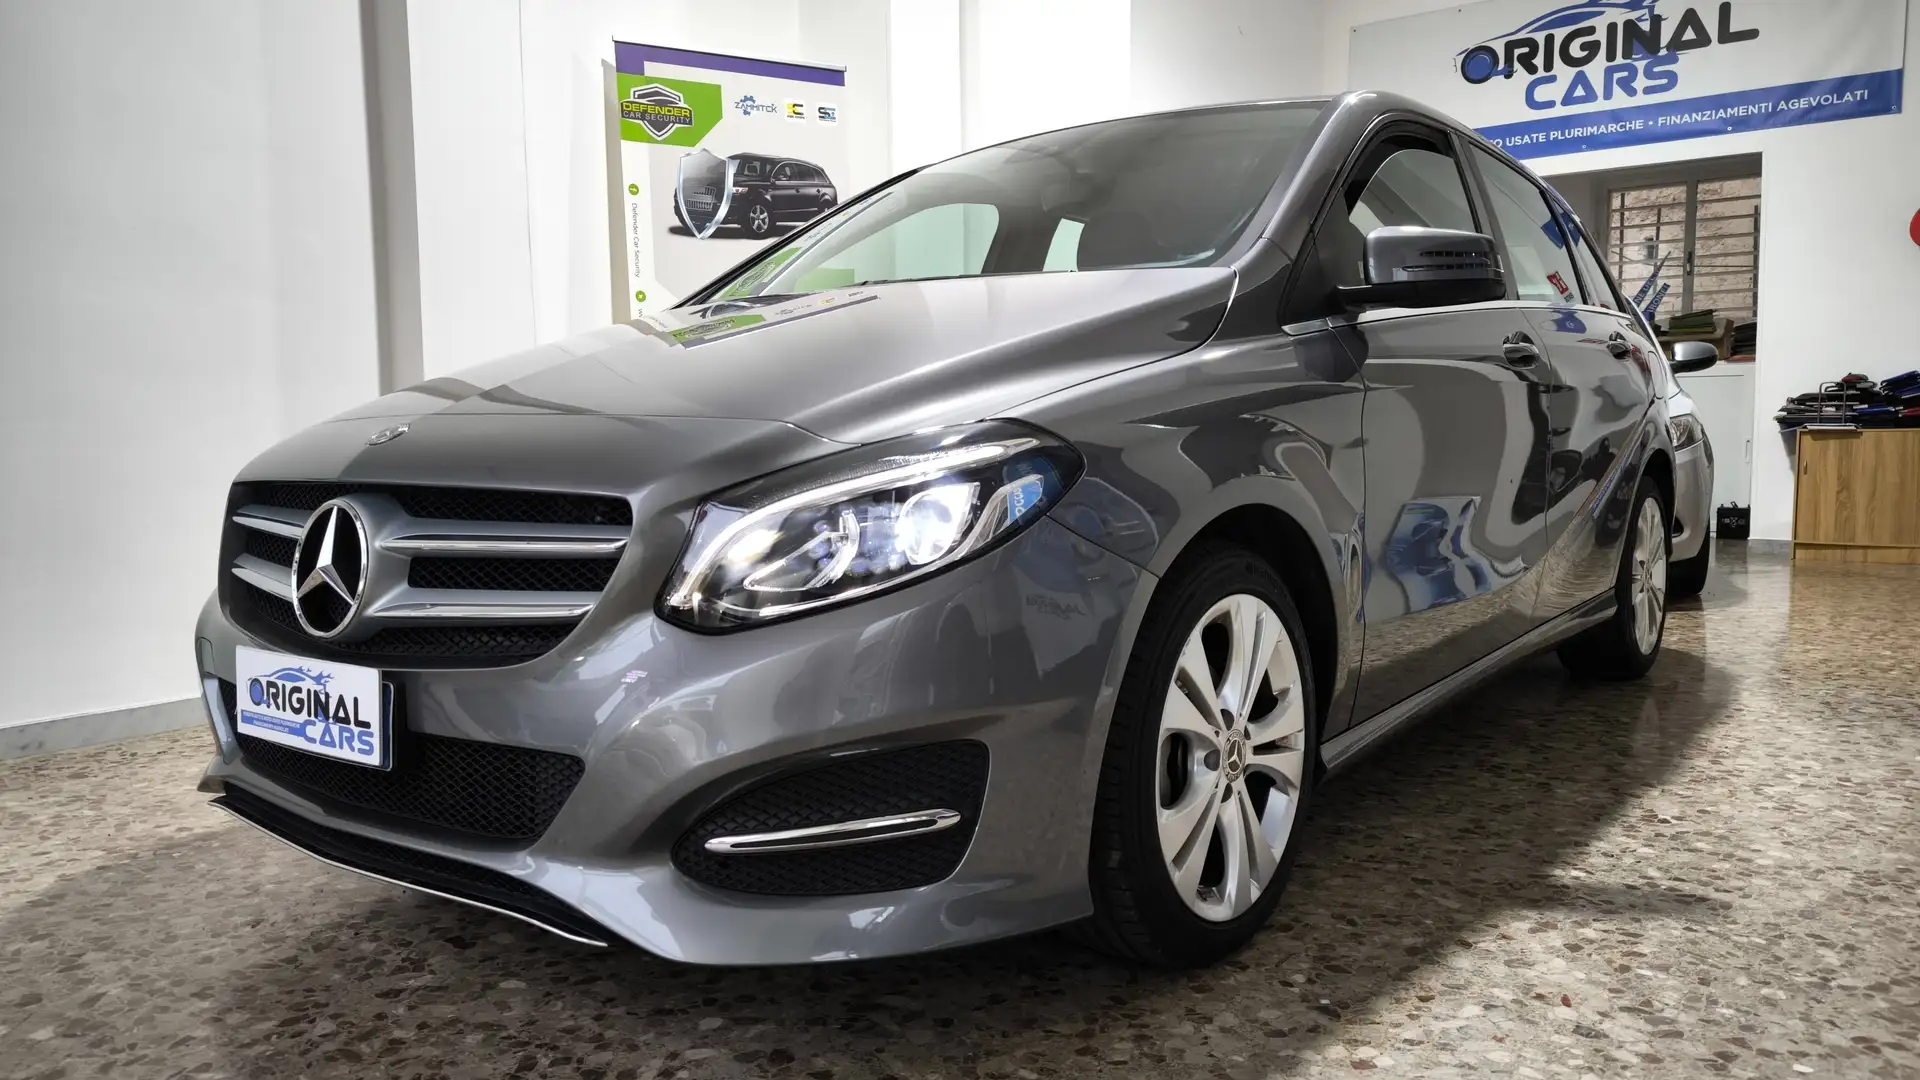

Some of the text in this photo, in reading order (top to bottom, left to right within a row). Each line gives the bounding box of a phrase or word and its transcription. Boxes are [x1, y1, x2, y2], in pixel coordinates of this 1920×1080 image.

[1460, 1, 1760, 84] ORIGINAL
[1525, 50, 1680, 110] CARS
[622, 102, 691, 117] DEFENDER
[623, 110, 691, 124] CAR SECURITY
[1505, 132, 1547, 147] USATE
[1549, 119, 1644, 141] PLURIMARCHE
[1658, 102, 1773, 127] FINANZIAMENTI
[1776, 89, 1869, 112] AGEVOLATI
[249, 677, 372, 730] ORIGINAL
[301, 719, 375, 756] CARS
